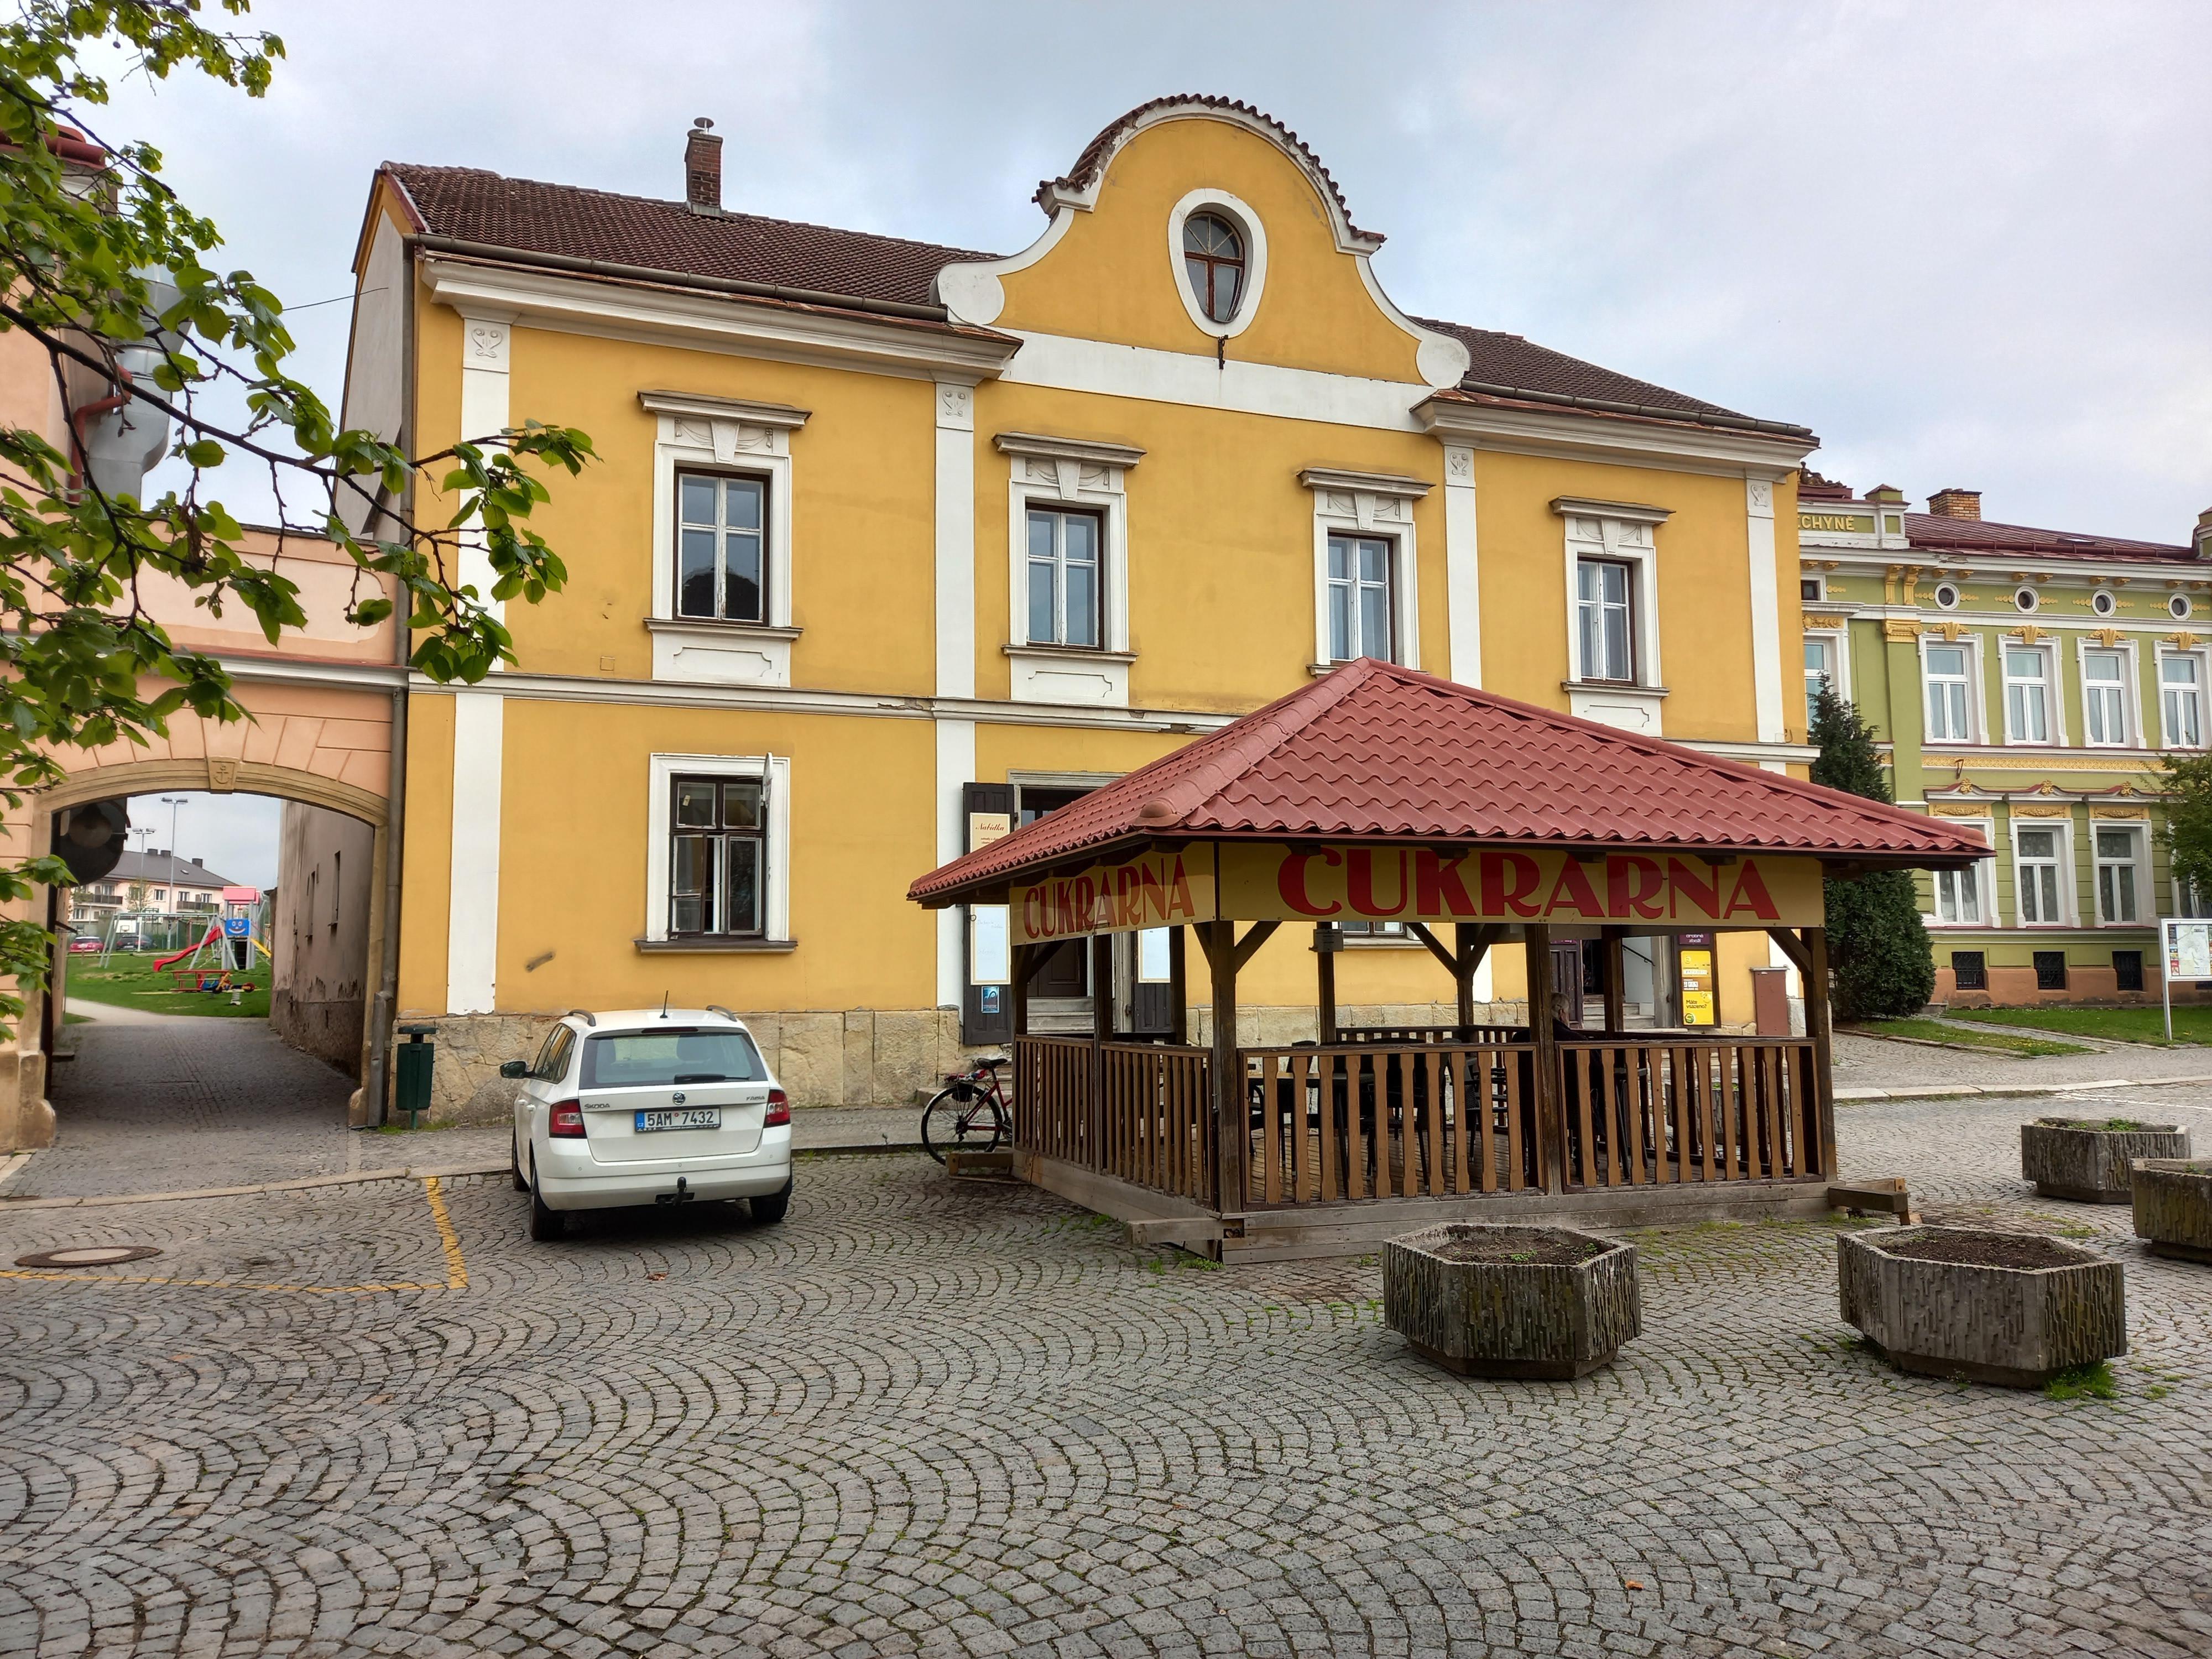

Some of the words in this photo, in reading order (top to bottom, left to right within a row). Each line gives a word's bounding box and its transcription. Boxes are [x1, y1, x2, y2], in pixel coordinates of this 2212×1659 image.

[975, 823, 1004, 831] Nabídka
[1024, 854, 1195, 938] CUKRARNA
[1277, 847, 1781, 920] CUKRARNA
[647, 1112, 672, 1126] 5AM
[681, 1110, 714, 1125] 7432
